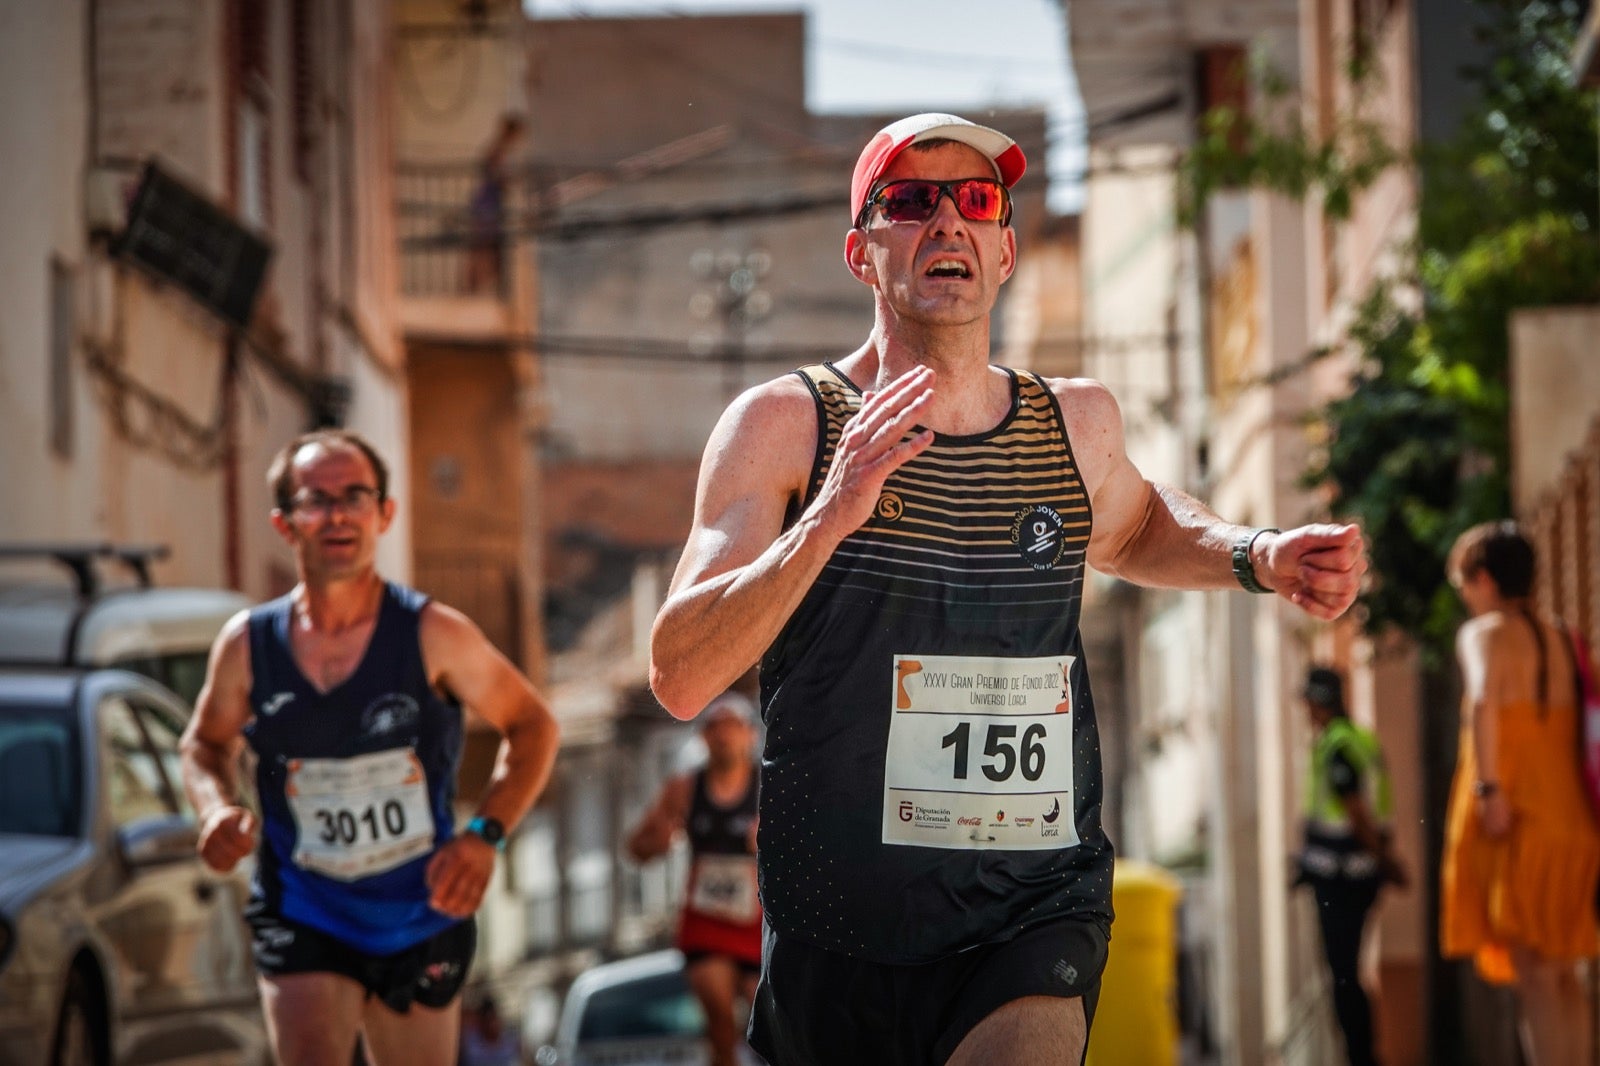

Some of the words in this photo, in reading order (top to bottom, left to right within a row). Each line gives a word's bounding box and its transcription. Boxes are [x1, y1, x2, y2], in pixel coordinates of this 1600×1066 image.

[1011, 505, 1035, 543] GRANADA
[1036, 505, 1063, 527] JOVEN
[923, 673, 947, 688] XXXV
[1043, 673, 1059, 689] 2022
[941, 722, 1047, 782] 156
[314, 799, 406, 845] 3010
[915, 806, 951, 816] Diputación
[923, 814, 951, 823] Granada
